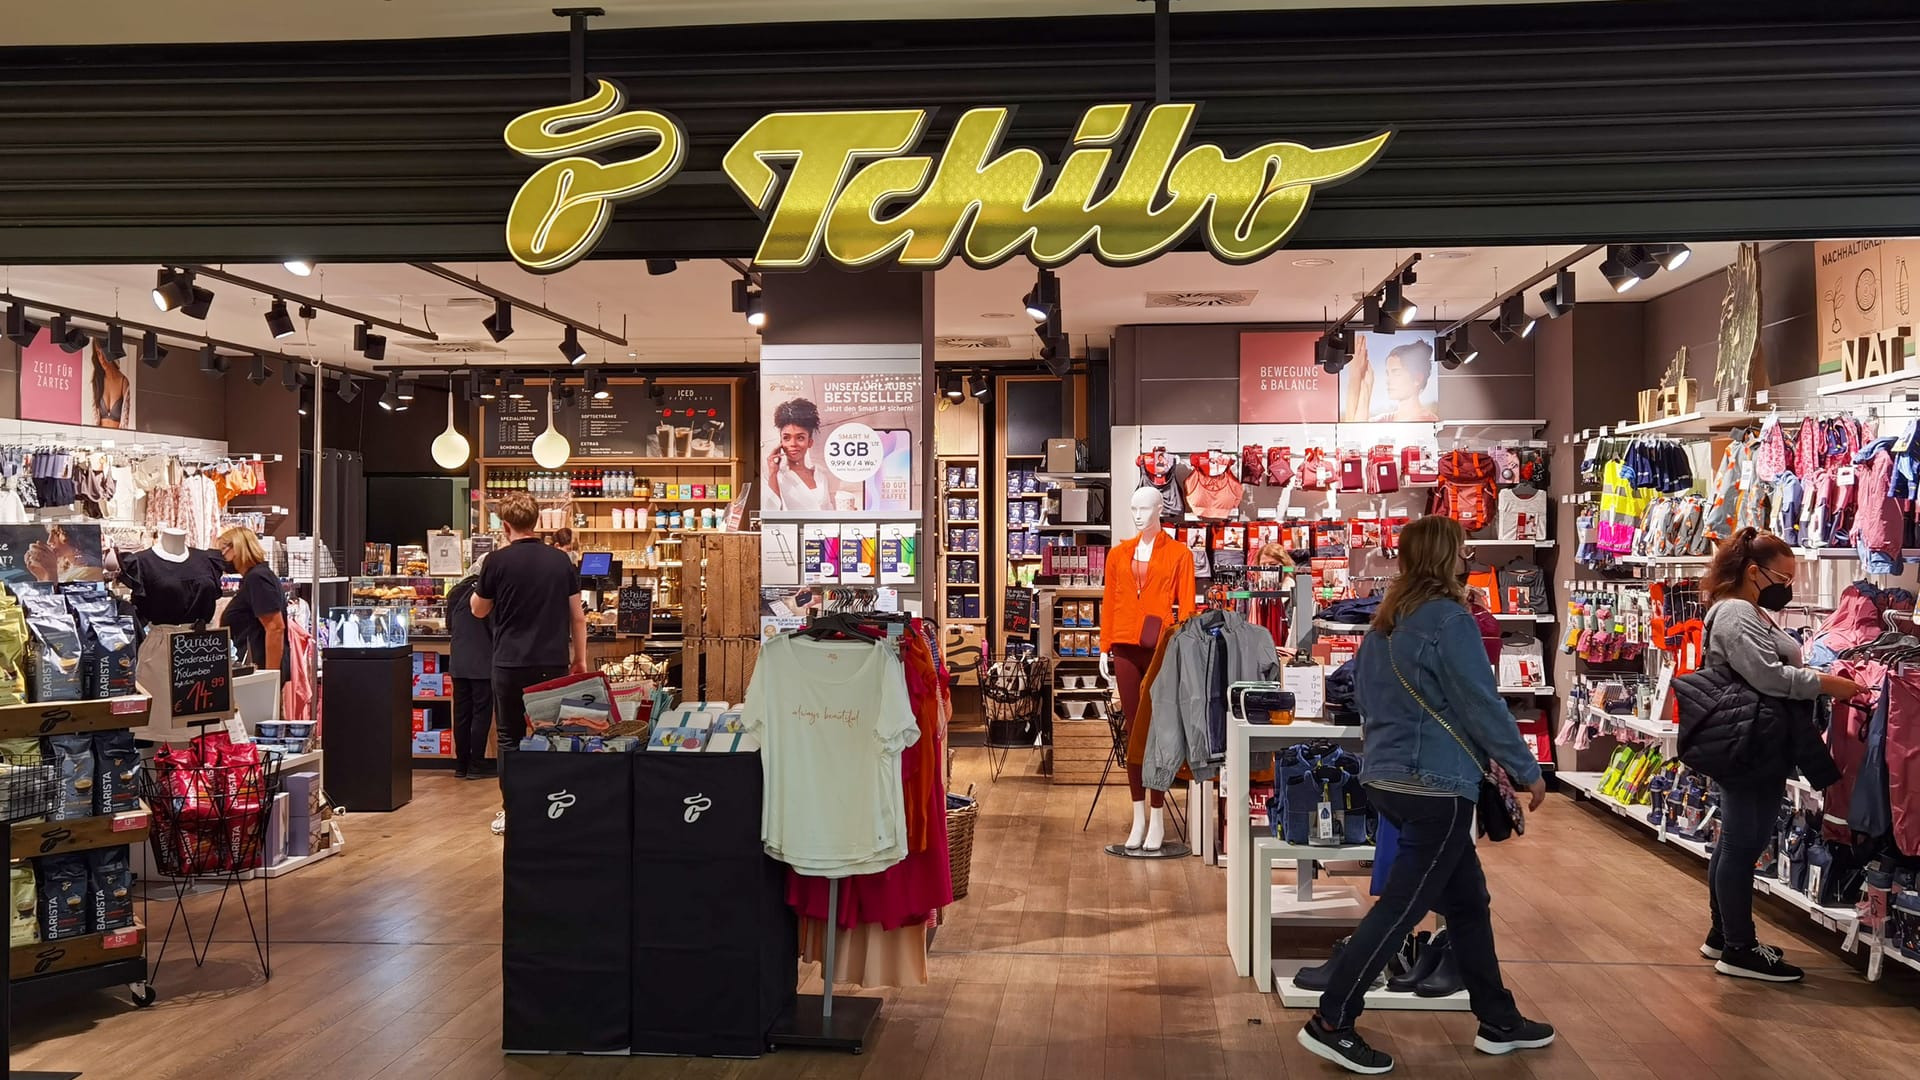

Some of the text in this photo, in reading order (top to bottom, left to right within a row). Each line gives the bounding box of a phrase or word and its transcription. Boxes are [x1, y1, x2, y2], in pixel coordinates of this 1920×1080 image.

[723, 103, 1392, 266] Tchibo
[33, 360, 73, 378] ZEIT FÜR
[1260, 366, 1319, 378] BEWEGUNG
[37, 375, 70, 391] ZARTES
[824, 382, 859, 392] UNSER
[1260, 379, 1319, 391] & BALANCE
[824, 391, 913, 403] BESTSELLER
[824, 405, 842, 413] Jetzt
[888, 405, 914, 413] sichern!
[829, 442, 841, 457] 3
[843, 442, 869, 457] GB
[893, 481, 907, 489] GUT
[174, 634, 222, 649] Barista
[174, 654, 227, 667] Sonderedition
[100, 655, 110, 698] BARISTA
[824, 706, 860, 728] beautiful
[103, 771, 112, 813] BARISTA
[96, 889, 105, 930] BARISTA
[48, 896, 58, 939] BARISTA
